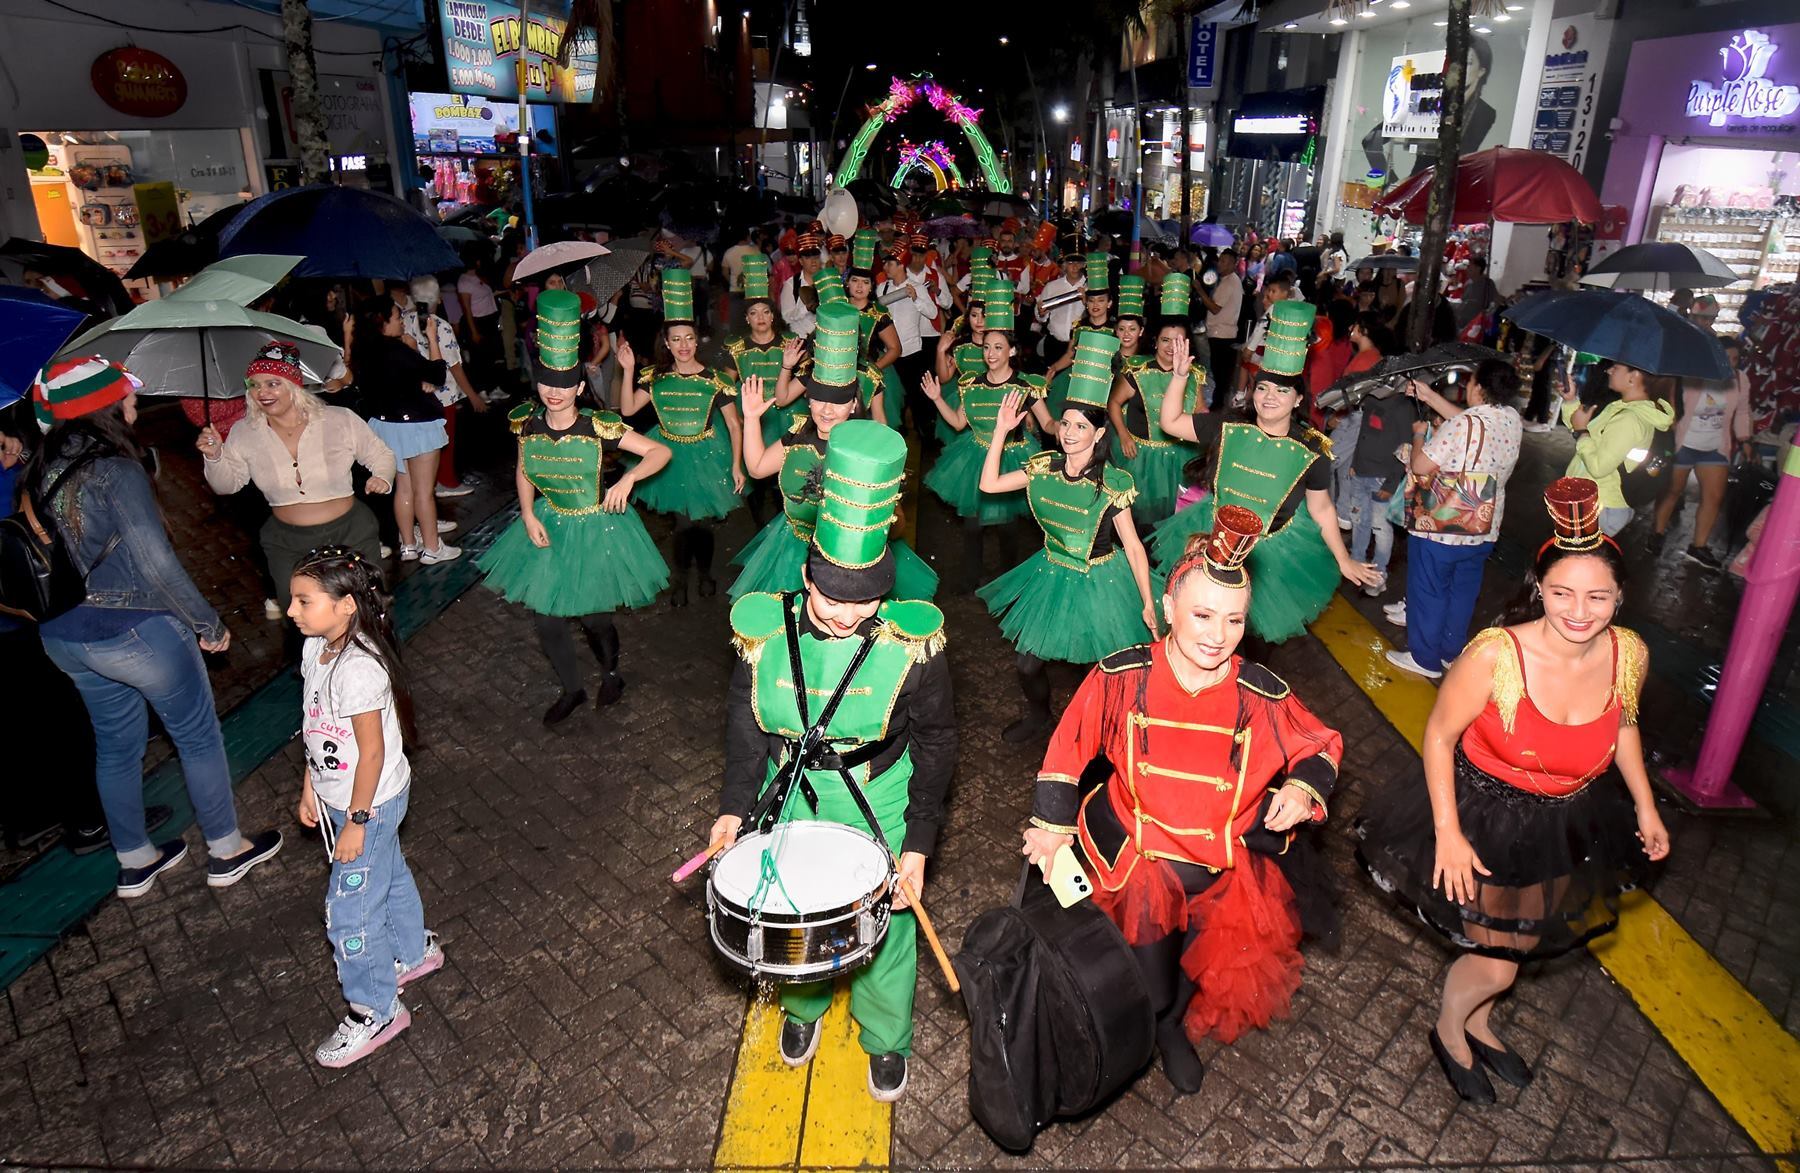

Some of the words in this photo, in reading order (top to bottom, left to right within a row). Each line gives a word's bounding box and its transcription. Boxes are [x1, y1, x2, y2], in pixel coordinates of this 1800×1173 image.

[453, 19, 486, 43] DESDE!
[491, 20, 511, 57] EL
[508, 17, 562, 60] BMBAZ
[447, 39, 471, 64] 1.000
[472, 47, 493, 67] 2.000
[452, 66, 474, 86] 5.000
[475, 67, 497, 90] 10.000
[529, 65, 541, 86] LA
[1685, 79, 1739, 124] Purple
[1741, 79, 1787, 115] Rose
[341, 155, 367, 171] PASE
[320, 722, 353, 739] CUTE!
